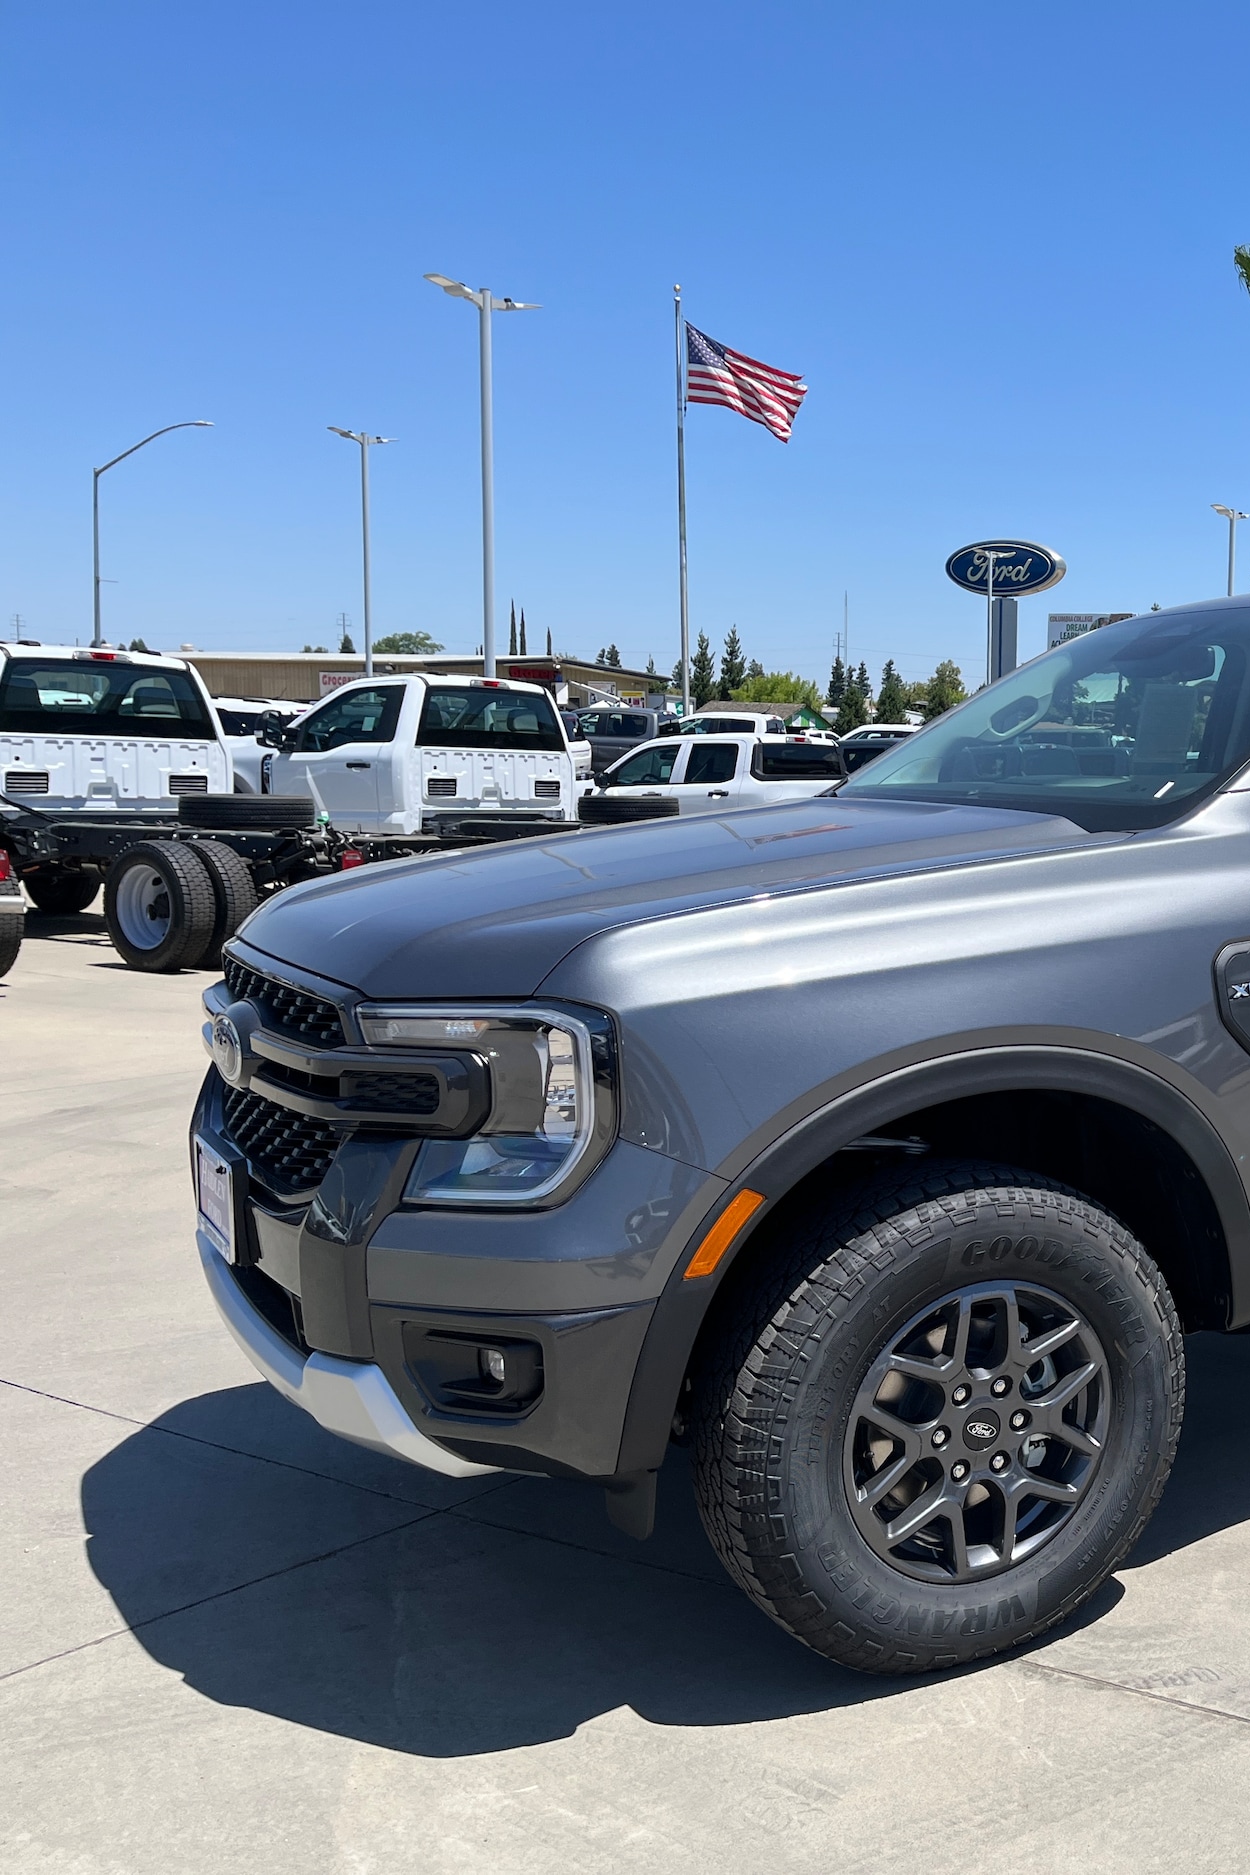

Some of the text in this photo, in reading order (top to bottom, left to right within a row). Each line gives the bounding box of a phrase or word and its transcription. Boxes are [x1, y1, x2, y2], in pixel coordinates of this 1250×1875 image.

[966, 549, 1033, 582] Ford
[1049, 615, 1093, 623] COLUMBIA COLLEGE
[1066, 623, 1088, 632] DREAM
[961, 1234, 1149, 1347] GOODYEAR
[871, 1295, 891, 1325] AT
[816, 1541, 1027, 1639] WRANGLER
